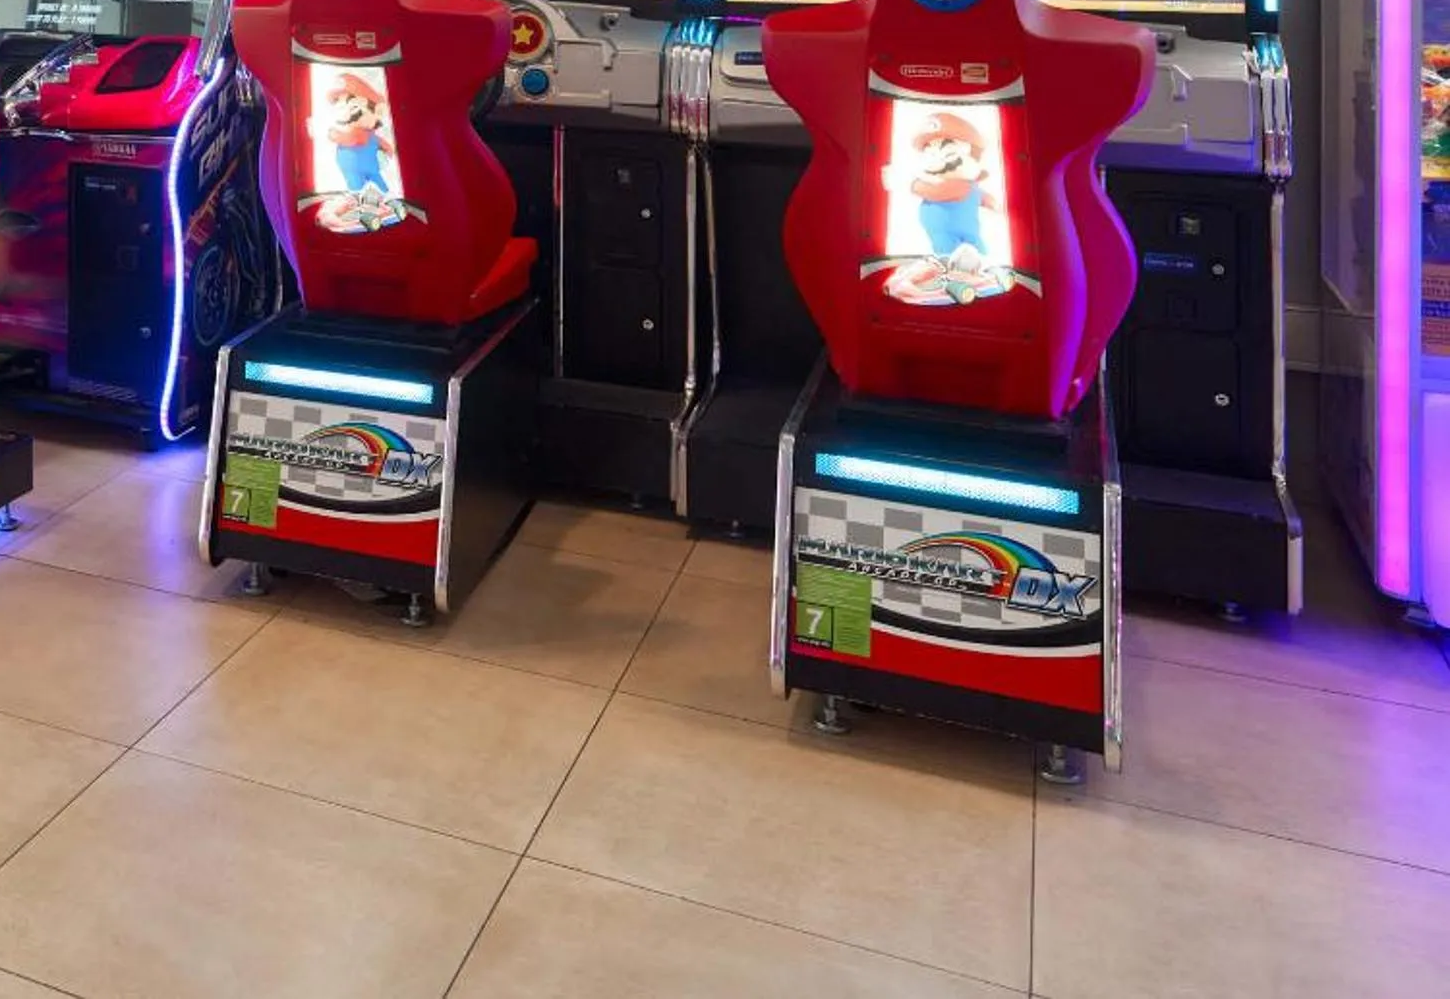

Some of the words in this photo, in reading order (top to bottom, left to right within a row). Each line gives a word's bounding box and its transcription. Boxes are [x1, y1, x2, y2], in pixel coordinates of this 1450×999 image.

[378, 450, 443, 490] DX
[230, 490, 243, 512] 7
[1008, 565, 1098, 619] DX
[805, 608, 824, 636] 7
